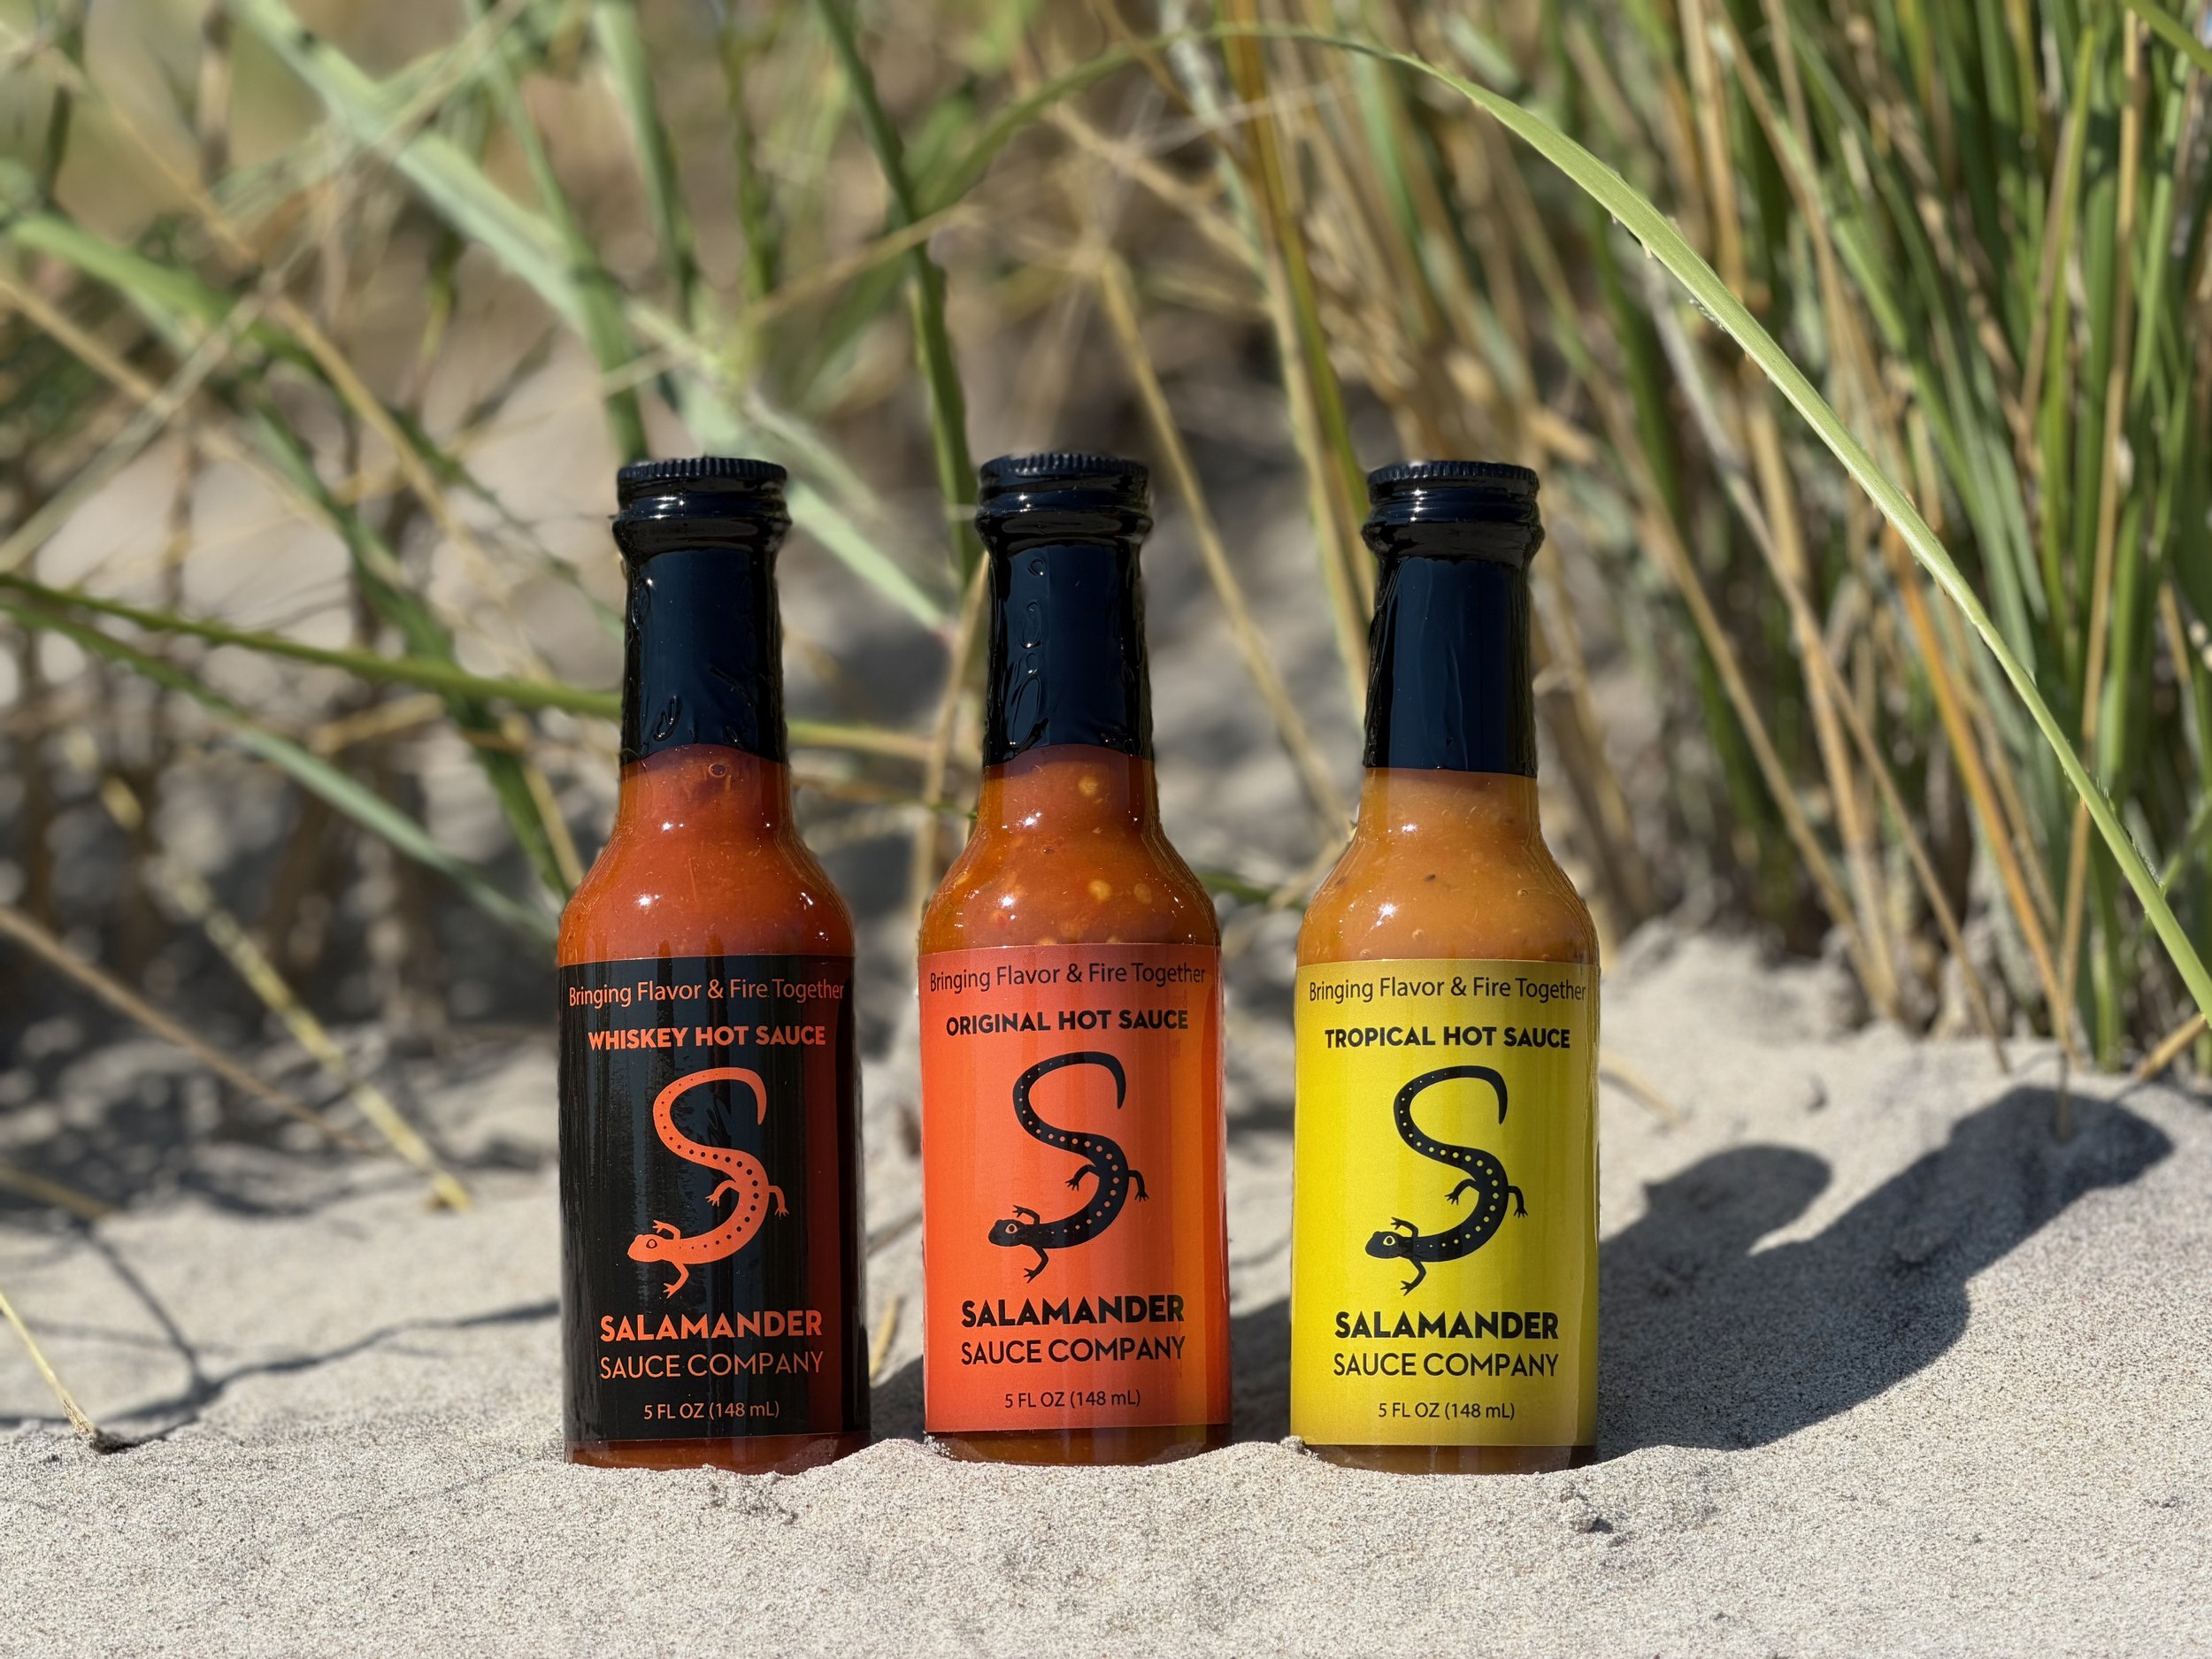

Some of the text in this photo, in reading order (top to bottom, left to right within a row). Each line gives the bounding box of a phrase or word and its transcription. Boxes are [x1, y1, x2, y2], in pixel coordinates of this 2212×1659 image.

[930, 963, 1205, 994] Bringing Flavor & Fire Together
[1310, 976, 1586, 1003] Bringing Flavor & Fire Together
[569, 979, 844, 1009] Bringing Flavor & Fire Together
[946, 1010, 1188, 1036] ORIGINAL HOT SAUCE
[588, 1025, 826, 1050] WHISKEY HOT SAUCE
[1325, 1026, 1571, 1048] TROPICAL HOT SAUCE
[962, 1294, 1184, 1327] SALAMANDER
[600, 1310, 822, 1342] SALAMANDER
[1334, 1310, 1559, 1339] SALAMANDER
[962, 1336, 1186, 1365] SAUCE COMPANY
[600, 1351, 824, 1379] SAUCE COMPANY
[1333, 1353, 1559, 1377] SAUCE COMPANY
[644, 1401, 780, 1420] 5 FL OZ (148 mL)
[1005, 1390, 1141, 1409] 5 FL OZ (148 mL)
[1379, 1402, 1515, 1420] 5 FL OZ (148 mL)
